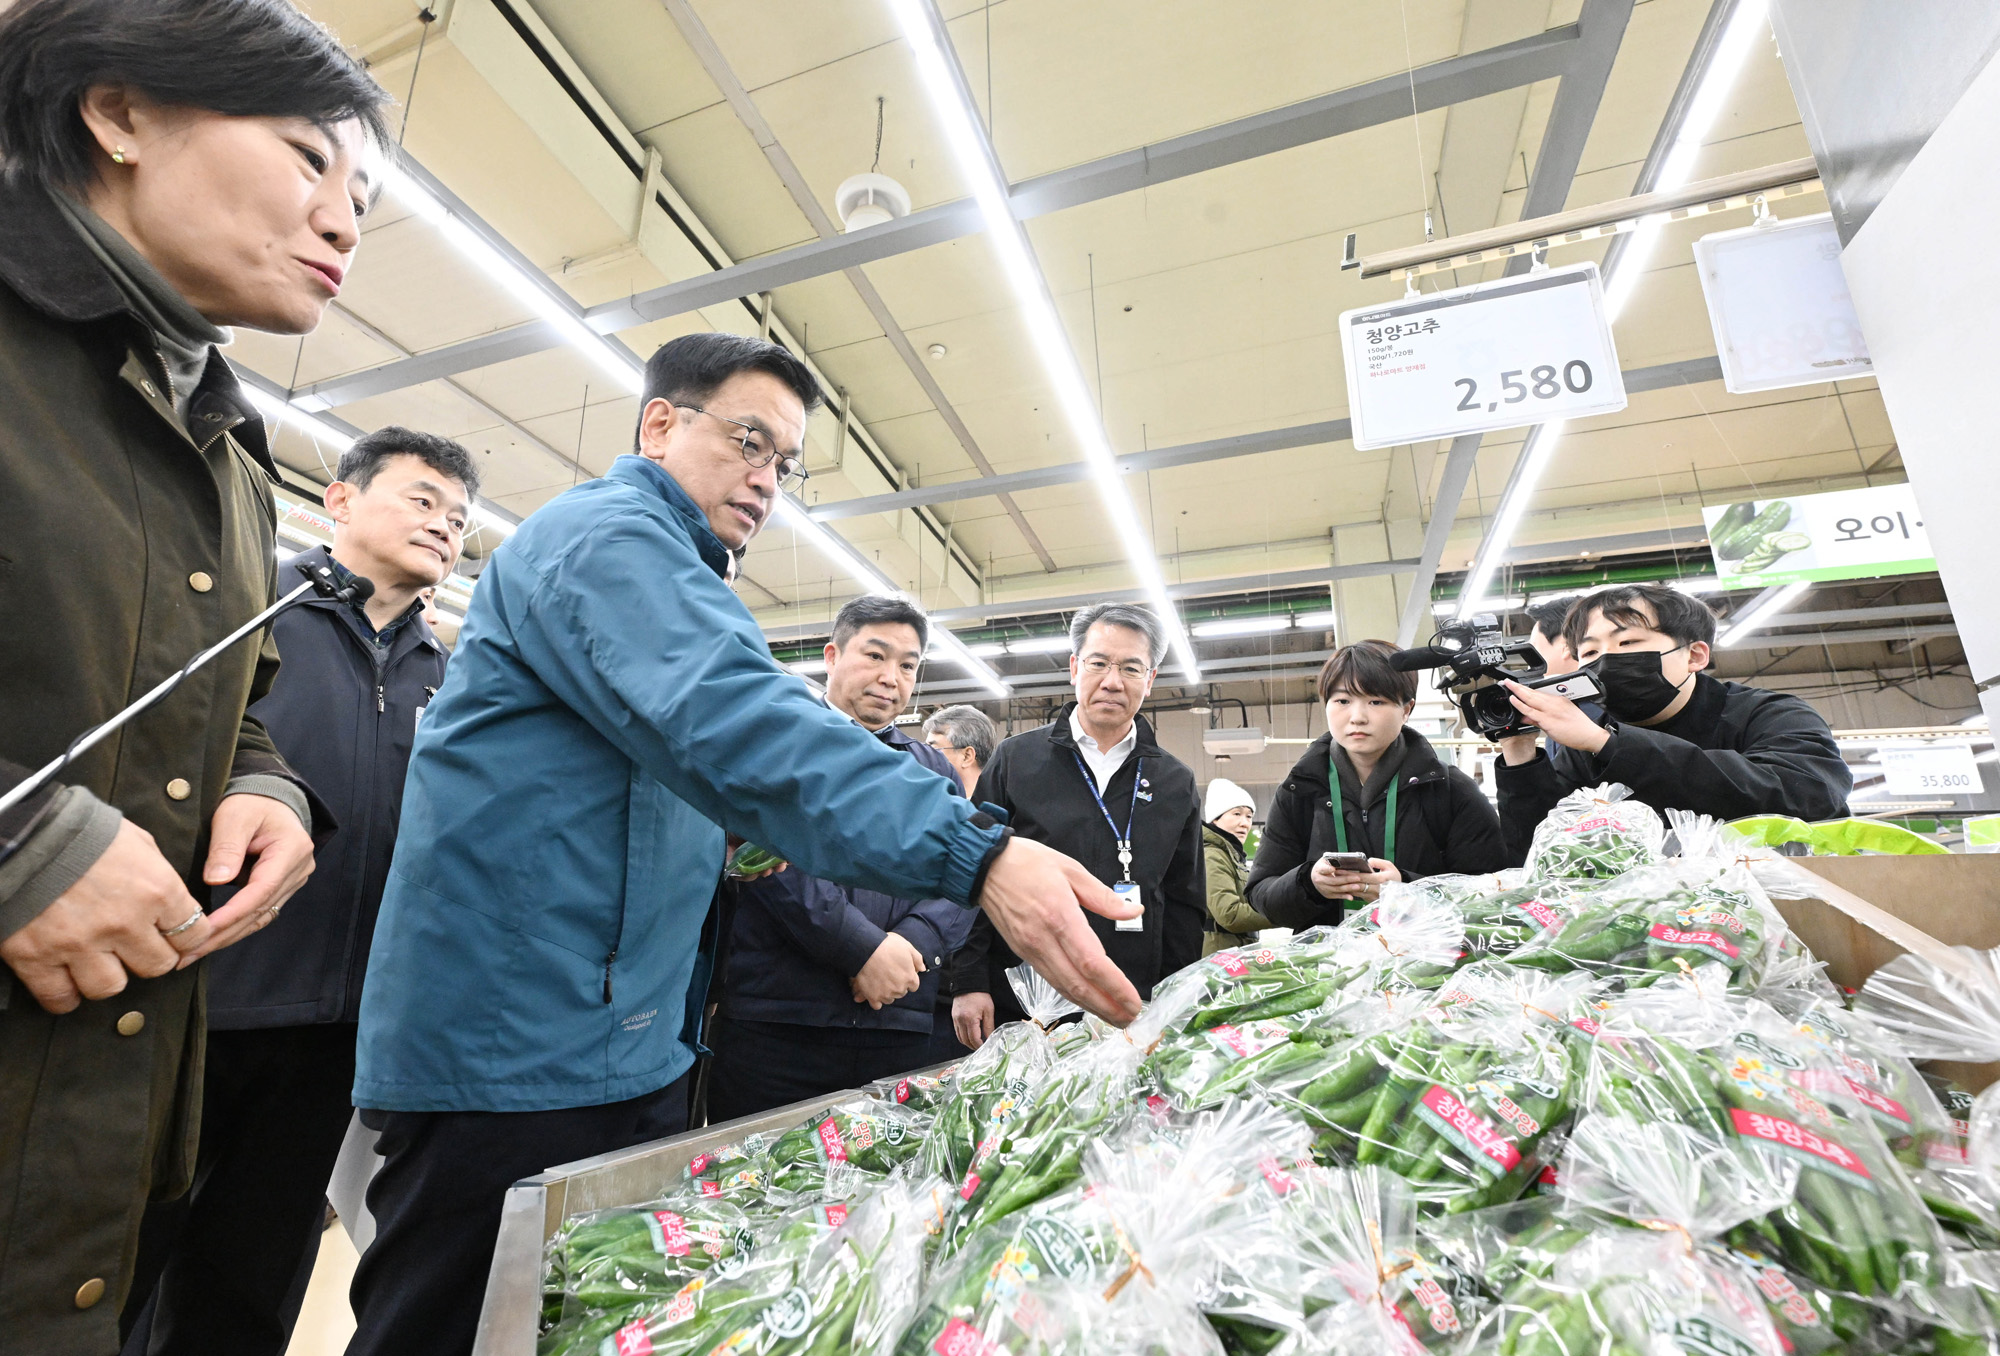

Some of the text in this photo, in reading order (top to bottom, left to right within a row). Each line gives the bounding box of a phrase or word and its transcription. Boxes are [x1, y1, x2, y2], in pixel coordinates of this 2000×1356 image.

[1366, 317, 1441, 345] 청양고추
[1369, 362, 1383, 370] 국산
[1454, 359, 1593, 413] 2,580
[1920, 774, 1970, 788] 35,800
[1662, 927, 1729, 951] 청양고추
[1709, 911, 1744, 935] 밀양
[1436, 1094, 1509, 1160] 청양고추
[1497, 1097, 1541, 1137] 밀양
[852, 1121, 874, 1148] 밀양
[1748, 1113, 1853, 1167] 청양고추
[1413, 1280, 1458, 1333] 밀양
[1757, 1267, 1817, 1327] 밀양
